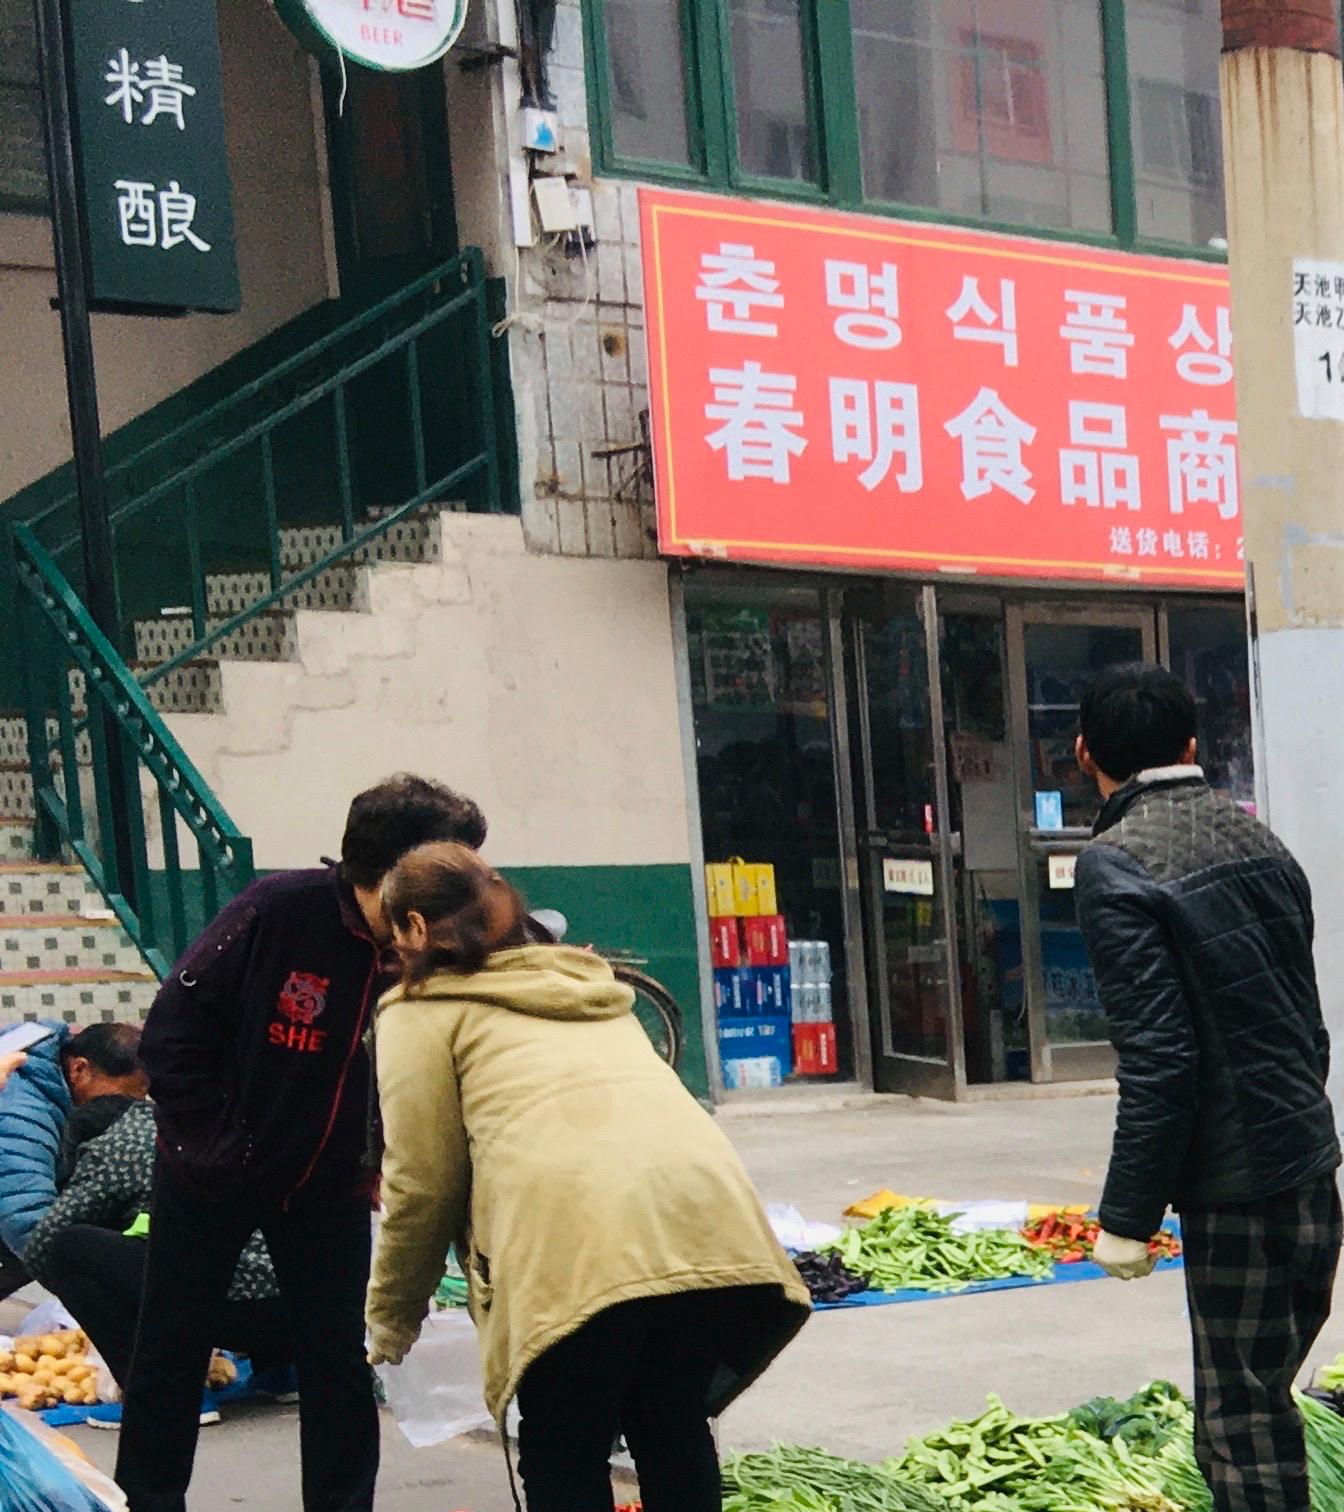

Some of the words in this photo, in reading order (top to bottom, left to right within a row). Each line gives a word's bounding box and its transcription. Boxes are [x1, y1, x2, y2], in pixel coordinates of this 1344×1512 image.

[360, 24, 403, 46] BEER
[104, 48, 211, 251] 精酿
[703, 360, 1241, 520] 春明食品商
[269, 1022, 328, 1052] SHE
